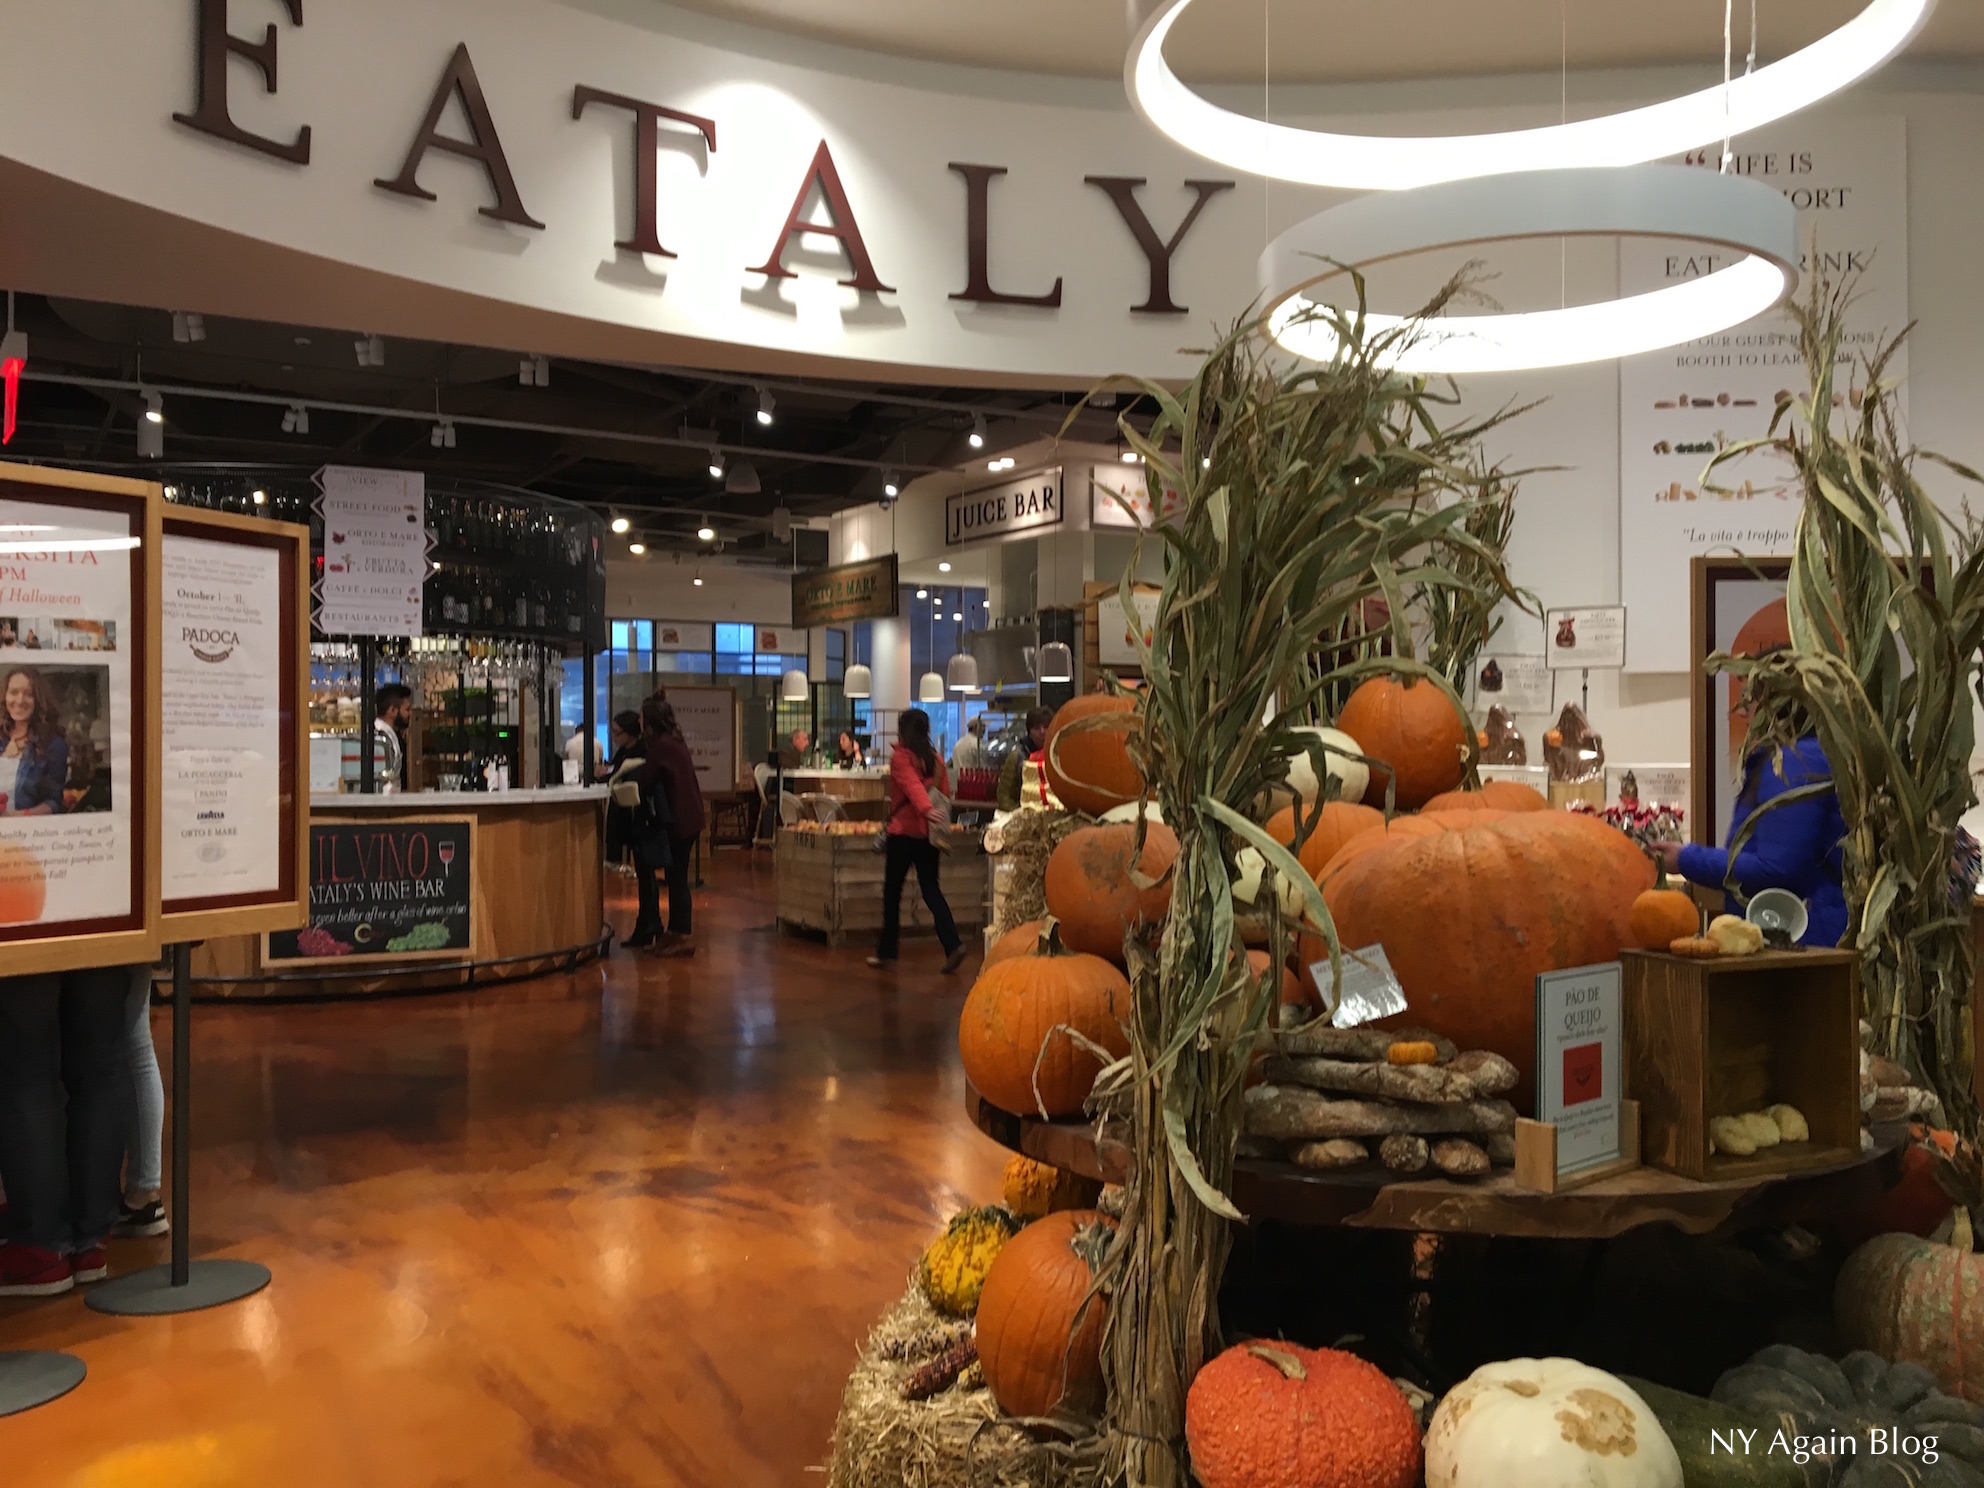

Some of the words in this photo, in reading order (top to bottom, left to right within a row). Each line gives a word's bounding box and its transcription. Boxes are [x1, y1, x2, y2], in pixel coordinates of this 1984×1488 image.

[172, 0, 1236, 314] EATALY
[1789, 152, 1813, 175] IS
[1783, 187, 1852, 210] ORT
[1665, 255, 1721, 278] EAT
[1698, 335, 1731, 348] OUR
[1735, 333, 1786, 347] GUEST
[1676, 353, 1731, 367] BOOTH
[1738, 353, 1758, 366] TO
[1763, 353, 1802, 365] LEAR
[352, 476, 378, 485] VIEW
[329, 500, 367, 511] STREET
[371, 503, 401, 513] FOOD
[953, 496, 1007, 538] JUICE
[1014, 486, 1055, 518] BAR
[347, 529, 376, 539] ORTO
[390, 531, 419, 542] MARE
[1710, 527, 1733, 542] vita
[1747, 527, 1790, 545] troppo
[364, 564, 414, 576] VERDURA
[10, 587, 82, 605] Halloween
[177, 587, 216, 601] October
[369, 586, 402, 596] DOLCI
[806, 583, 834, 602] ORTO
[846, 575, 878, 596] MARE
[324, 612, 400, 624] RESTAURANTS
[182, 626, 240, 645] PADOCA
[180, 828, 206, 839] ORTO
[214, 826, 238, 837] MARE
[316, 834, 354, 883] IL
[354, 832, 430, 881] VINO
[309, 883, 365, 904] ATALY'S
[370, 880, 410, 901] WINE
[415, 879, 446, 899] BAR
[337, 906, 361, 923] better
[364, 905, 387, 922] after
[1587, 986, 1601, 1003] DE
[1564, 1006, 1602, 1032] QUEIJO
